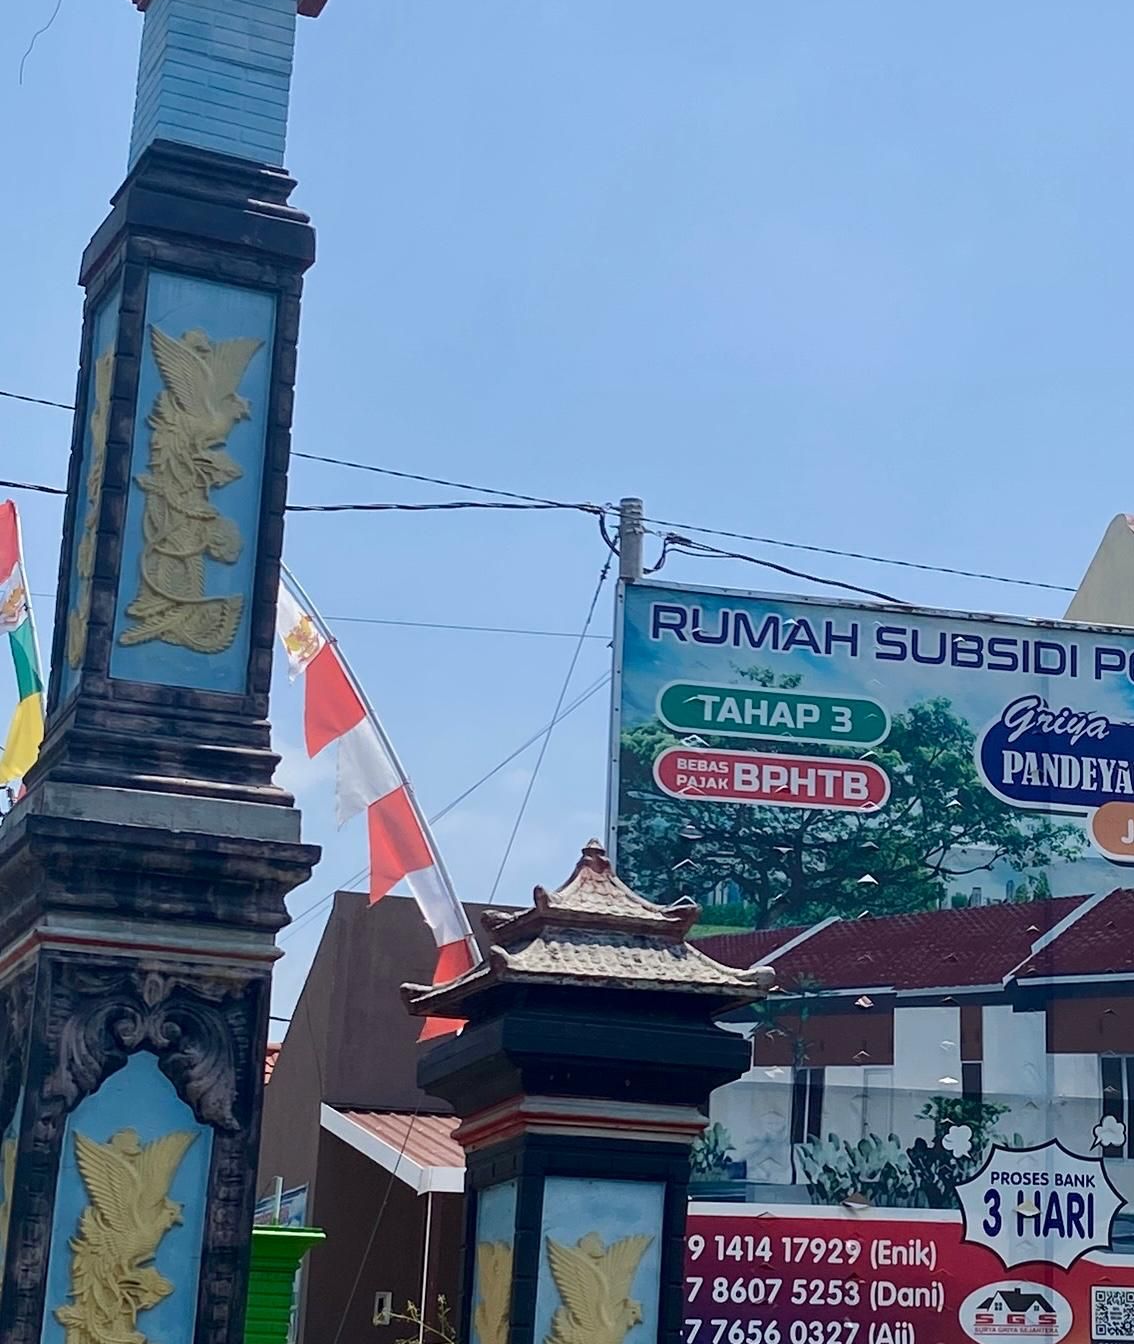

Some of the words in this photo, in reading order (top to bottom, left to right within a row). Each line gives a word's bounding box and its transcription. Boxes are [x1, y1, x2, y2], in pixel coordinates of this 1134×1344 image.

[652, 604, 859, 657] RUMAH
[875, 626, 1078, 678] SUBSIDI
[698, 694, 821, 730] TAHAP
[831, 706, 853, 733] 3
[1003, 698, 1110, 746] Griya
[676, 758, 729, 774] BEBAS
[733, 762, 869, 801] BPHTB
[676, 774, 729, 790] PAJAK
[990, 1171, 1049, 1186] PROSES
[1055, 1173, 1096, 1188] BANK
[983, 1188, 1002, 1237] 3
[1017, 1189, 1094, 1239] HARI
[714, 1235, 773, 1261] 1414
[781, 1236, 862, 1264] 17929
[870, 1238, 937, 1272] (Enik)
[711, 1276, 783, 1304] 8607
[791, 1279, 861, 1306] 5253
[870, 1280, 945, 1313] (Dani)
